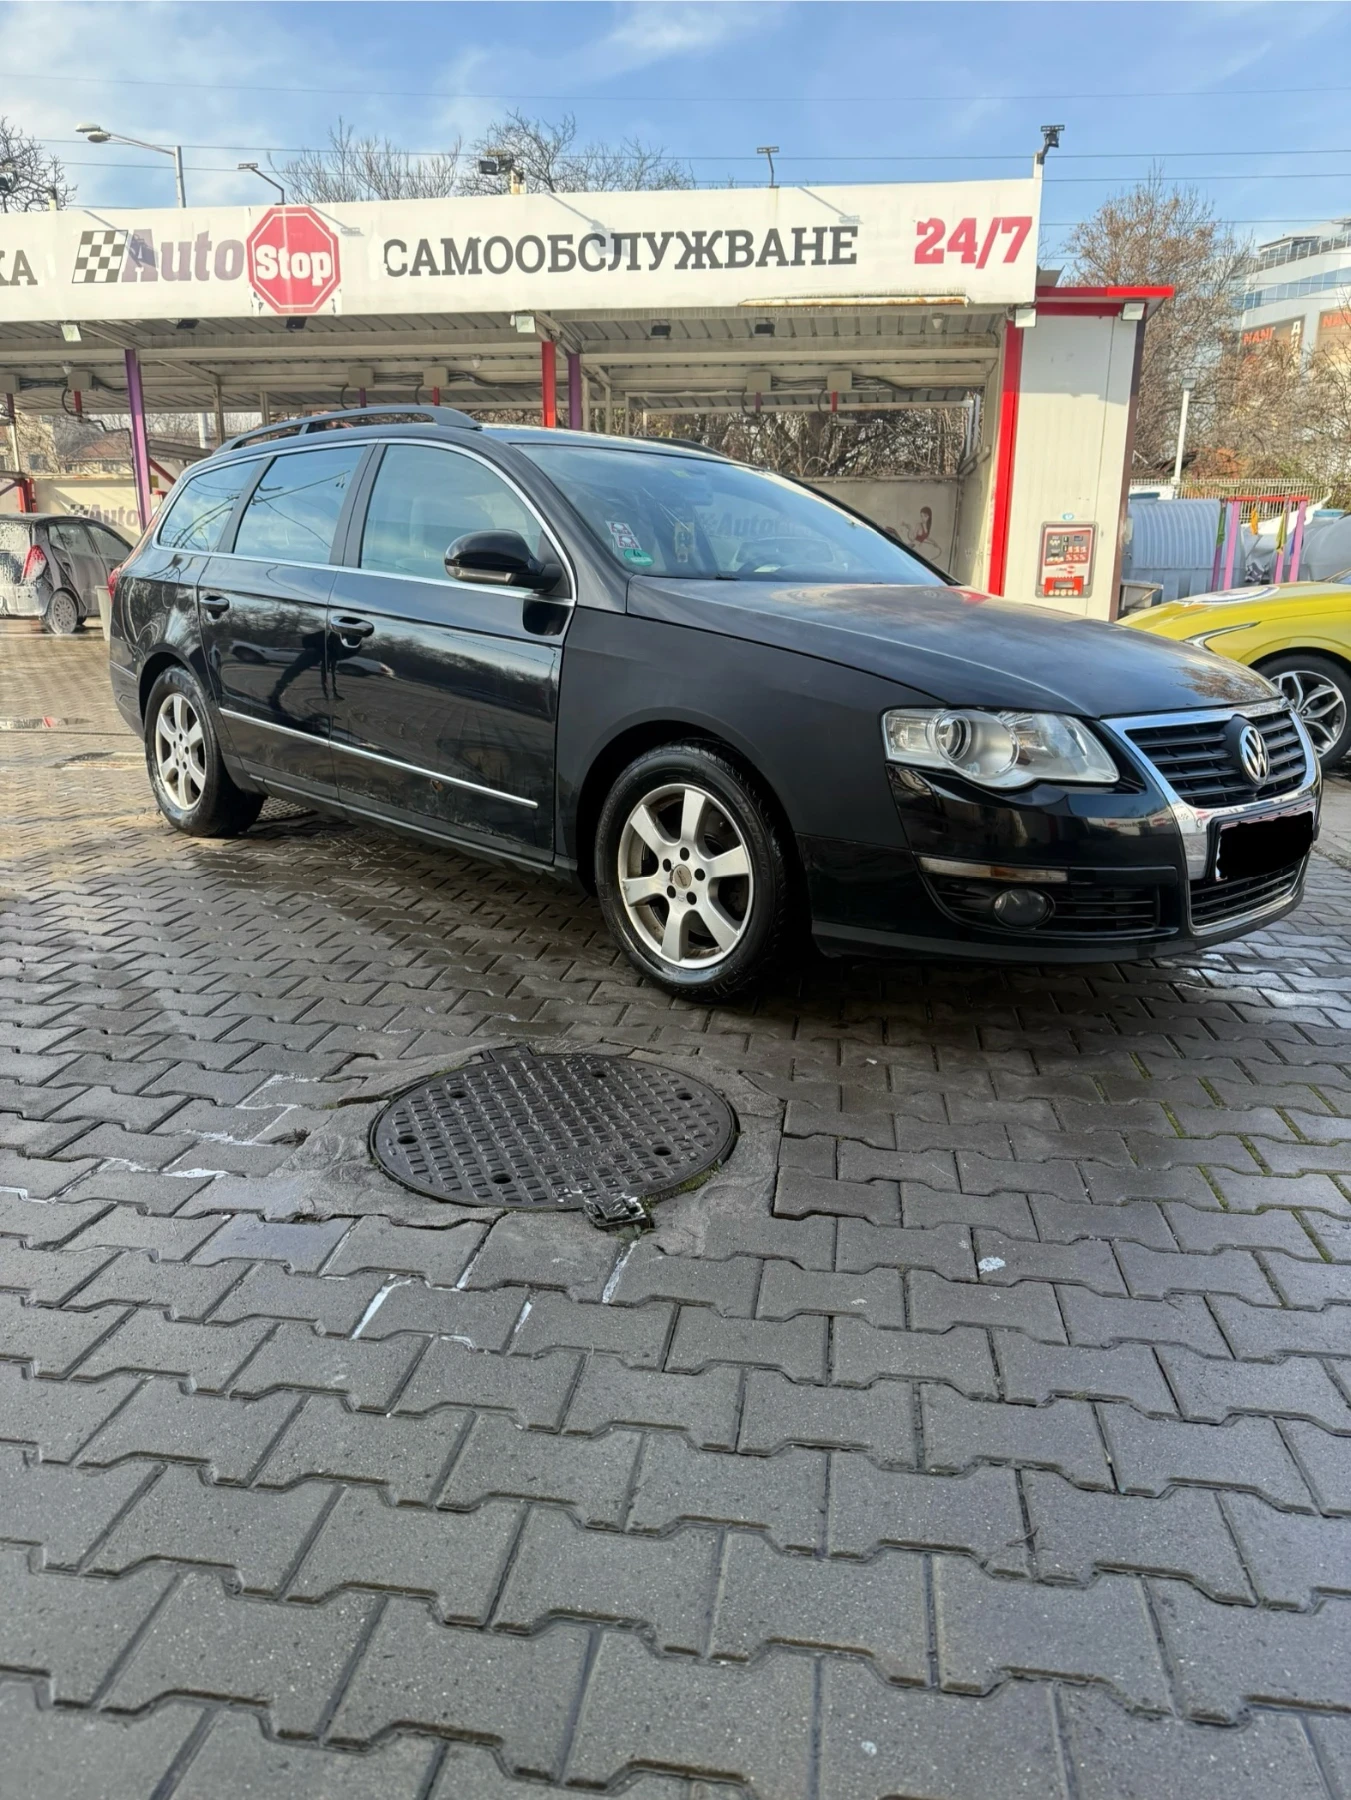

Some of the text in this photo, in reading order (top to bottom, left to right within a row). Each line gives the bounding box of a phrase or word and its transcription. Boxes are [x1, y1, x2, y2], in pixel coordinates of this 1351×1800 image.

[121, 228, 332, 287] Auto Stop
[383, 225, 858, 277] САМООБСЛУЖВАНЕ
[914, 216, 1033, 269] 24/7
[89, 504, 138, 526] Auto
